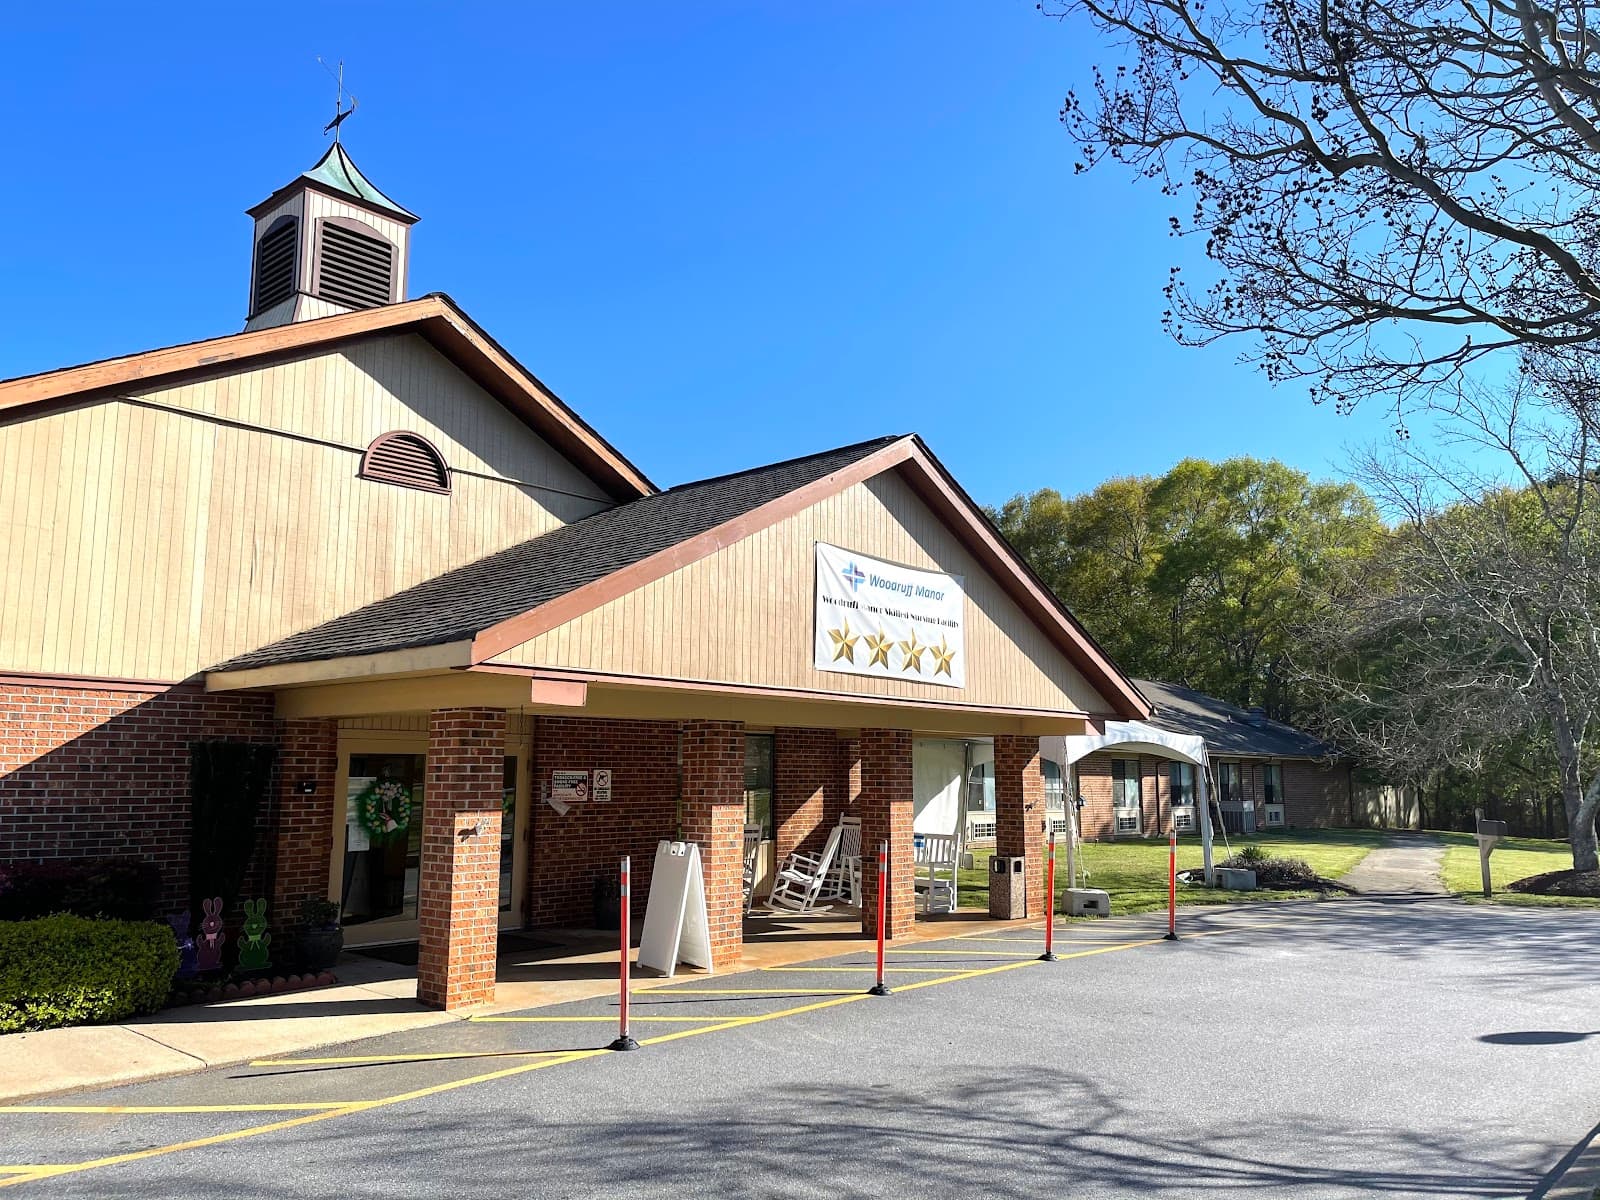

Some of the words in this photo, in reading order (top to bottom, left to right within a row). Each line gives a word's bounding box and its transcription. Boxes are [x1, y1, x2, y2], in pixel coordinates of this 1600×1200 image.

[869, 573, 914, 597] Woodruff
[915, 585, 945, 602] Manor
[884, 606, 909, 619] Skilled
[910, 612, 936, 625] Nursing
[937, 616, 959, 628] Facility
